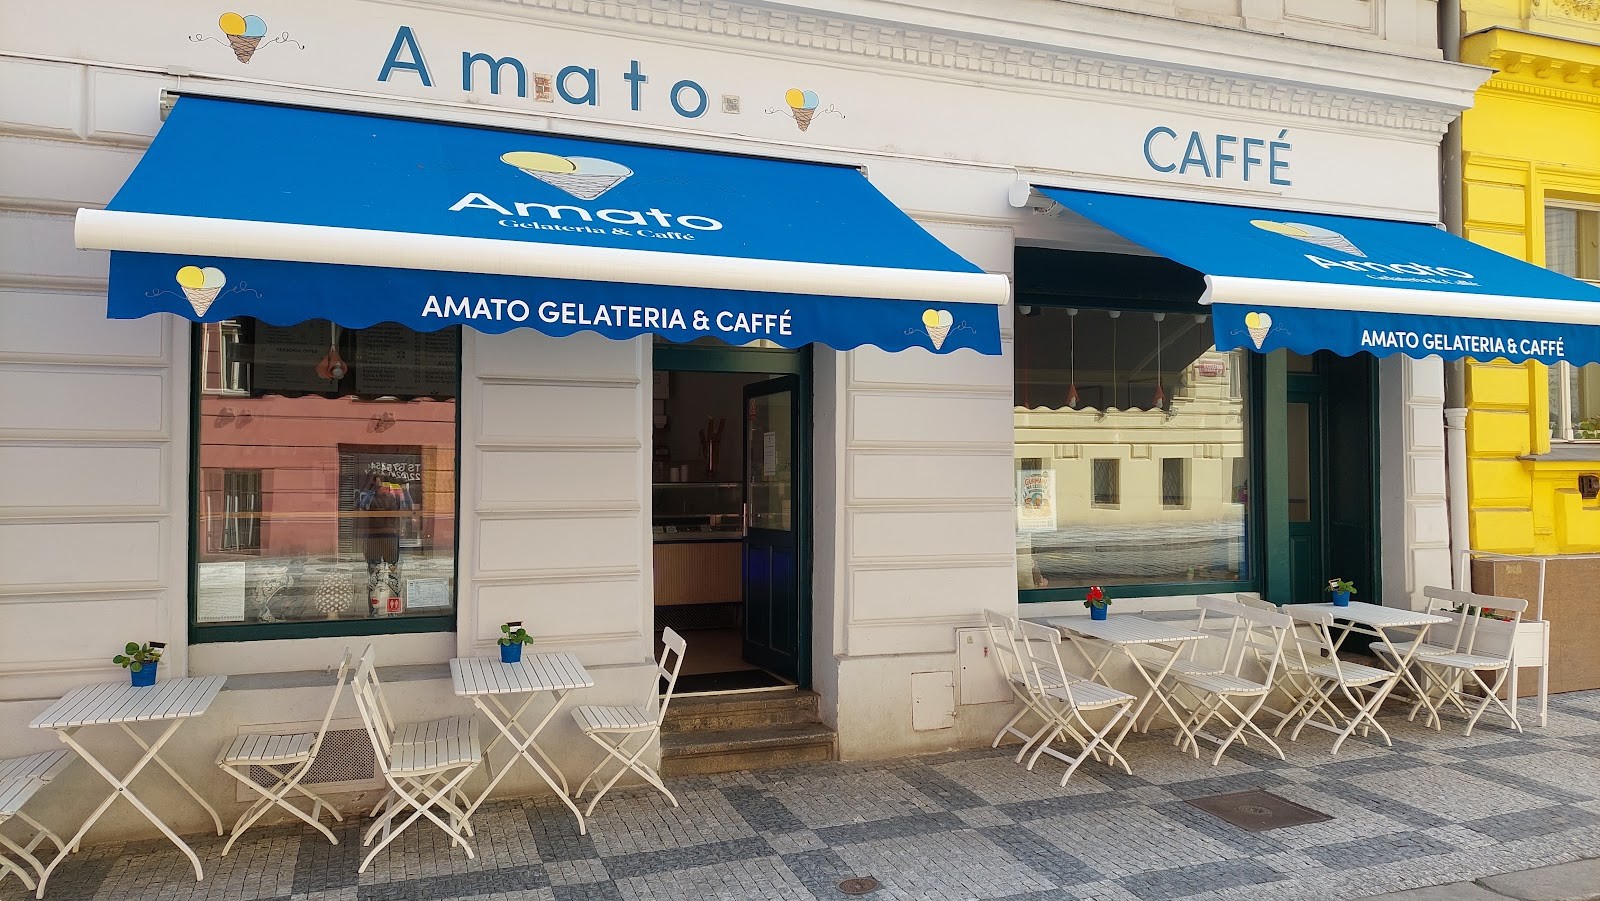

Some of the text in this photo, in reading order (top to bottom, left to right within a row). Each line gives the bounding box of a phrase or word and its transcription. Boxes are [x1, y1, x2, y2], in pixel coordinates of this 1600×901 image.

[377, 25, 711, 119] Amato
[1143, 126, 1294, 187] CAFFÉ
[448, 192, 723, 232] Amato
[498, 219, 697, 241] Gelateria & Caffé
[1304, 253, 1475, 279] Amato
[421, 295, 792, 336] AMATO GELATERIA & CAFFÉ
[1360, 329, 1565, 357] AMATO GELATERIA & CAFFÉ
